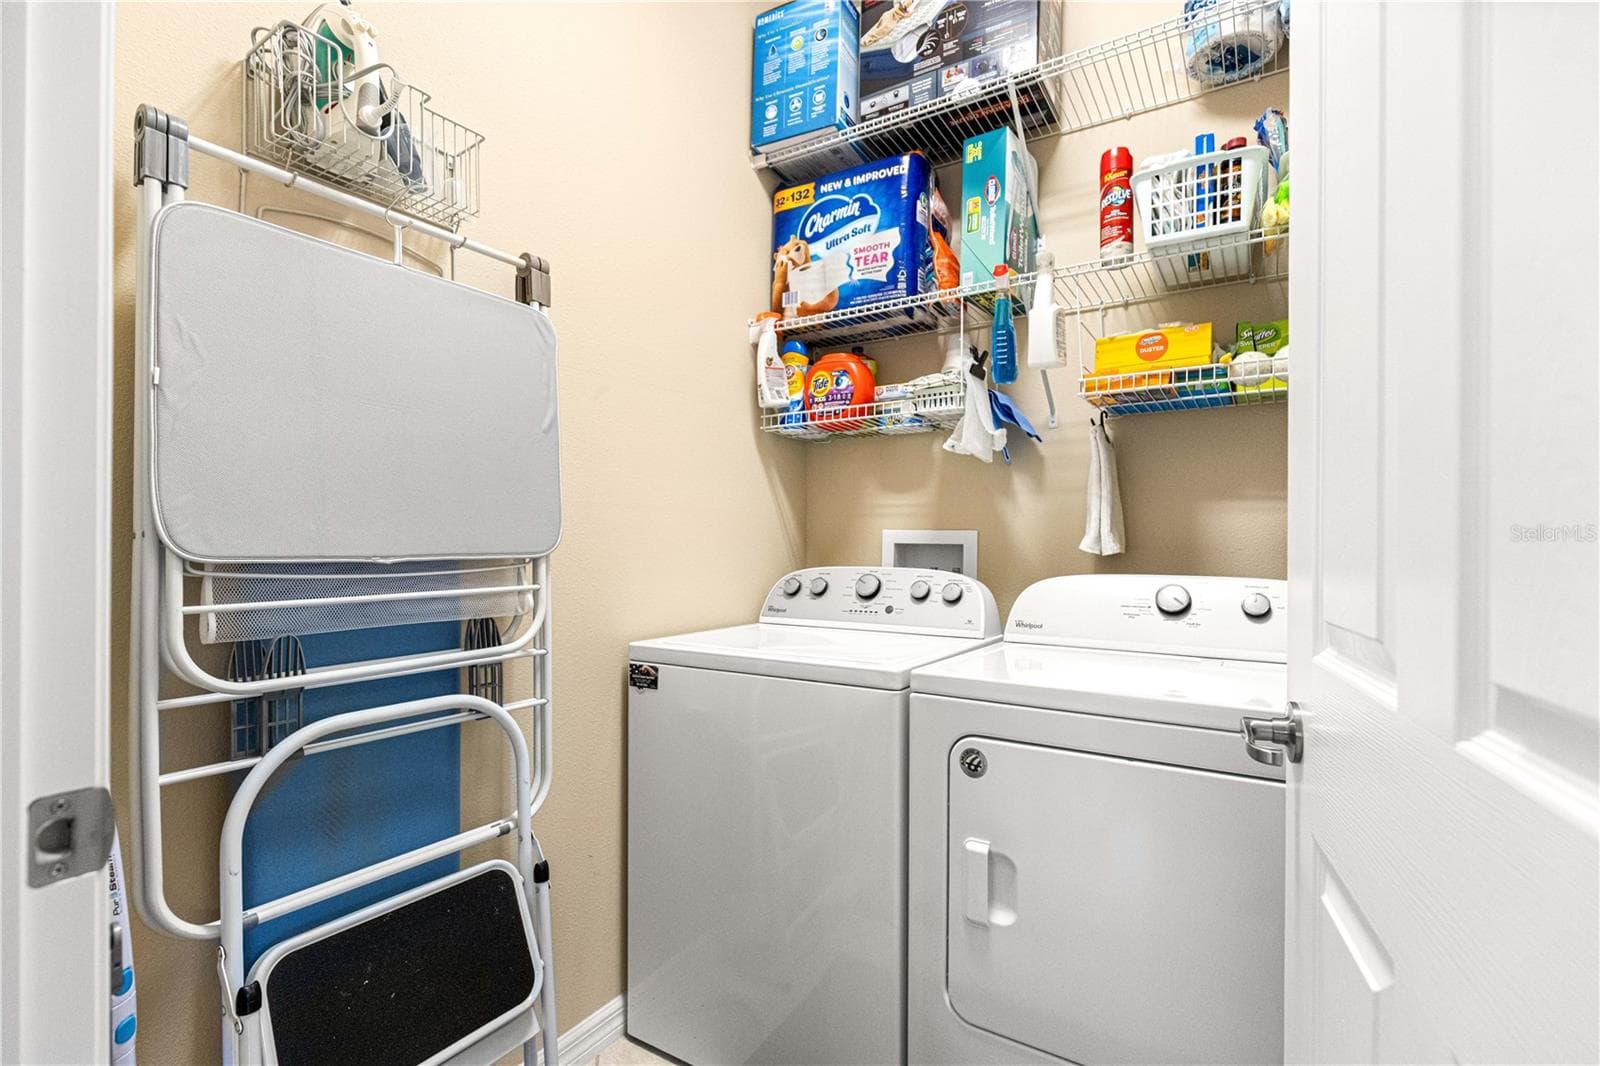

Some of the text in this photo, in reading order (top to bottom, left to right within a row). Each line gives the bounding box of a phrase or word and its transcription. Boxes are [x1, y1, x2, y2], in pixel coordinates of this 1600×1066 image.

[820, 164, 908, 194] NEW & IMPROVED
[804, 200, 860, 238] Charmin
[825, 222, 873, 251] Ultra Soft
[853, 241, 891, 256] SMOOTH
[854, 251, 889, 268] TEAR
[1240, 327, 1277, 340] Swffer
[812, 377, 829, 393] Tide
[1015, 620, 1044, 631] Whirlpool
